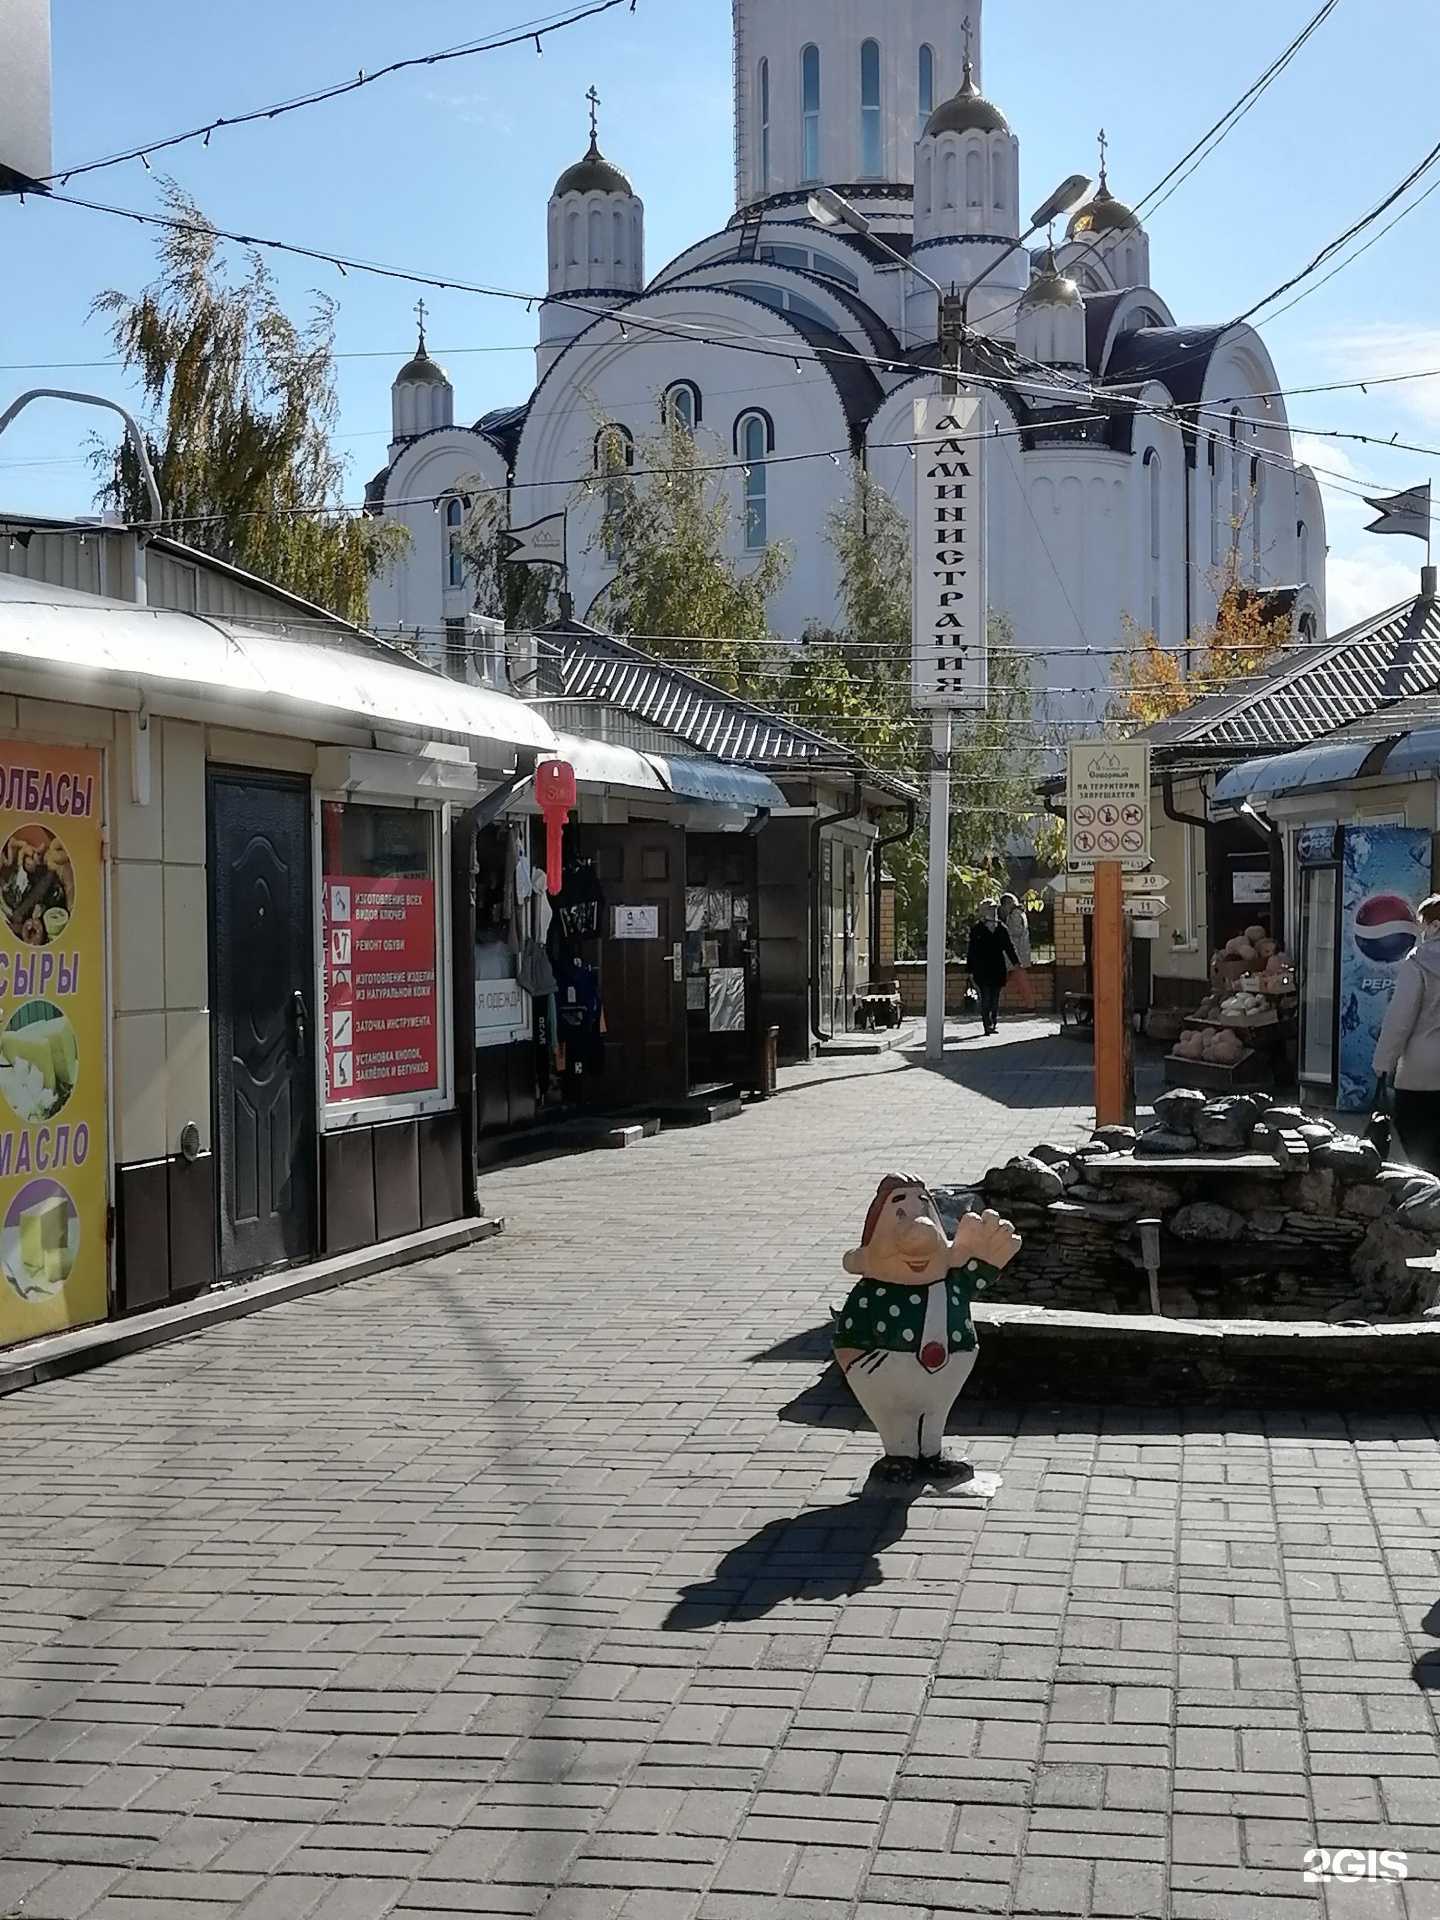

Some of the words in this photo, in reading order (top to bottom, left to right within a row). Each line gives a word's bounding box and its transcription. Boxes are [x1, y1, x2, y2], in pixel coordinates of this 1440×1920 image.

[926, 415, 974, 692] АДМИНИСТРАЦИЯ
[0, 953, 79, 997] СЫРЫ
[0, 1123, 89, 1176] МАСЛО
